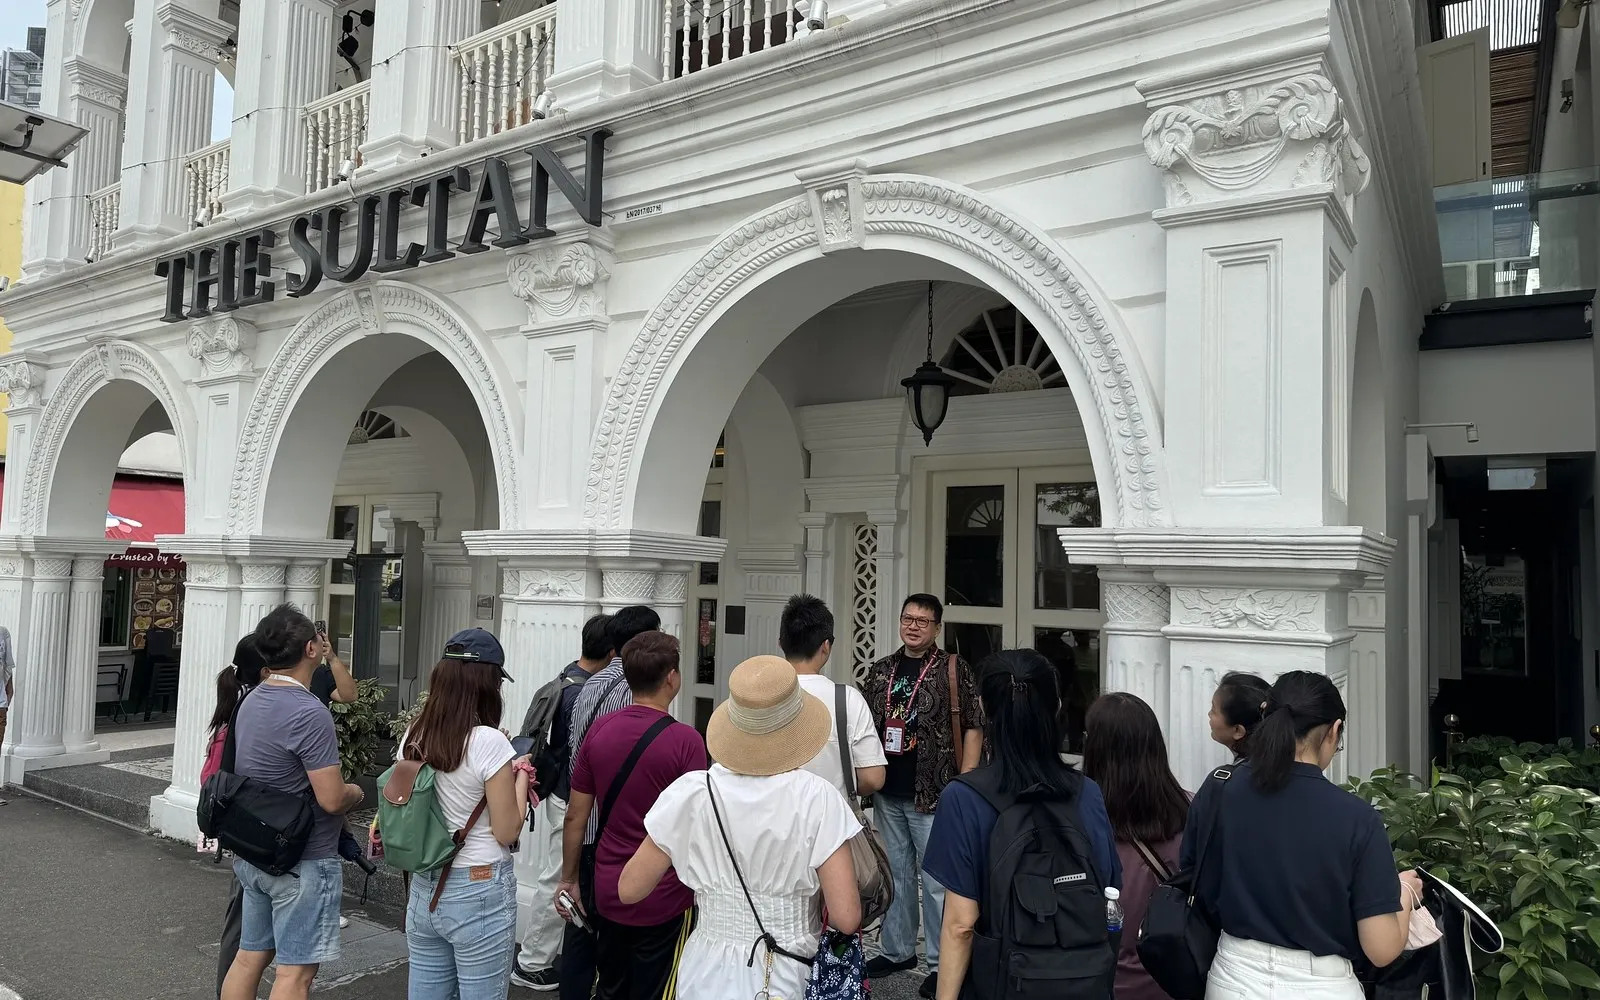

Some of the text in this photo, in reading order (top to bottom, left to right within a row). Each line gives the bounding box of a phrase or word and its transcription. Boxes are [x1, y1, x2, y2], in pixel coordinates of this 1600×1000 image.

[155, 128, 614, 322] THE SULTAN
[157, 552, 169, 565] by
